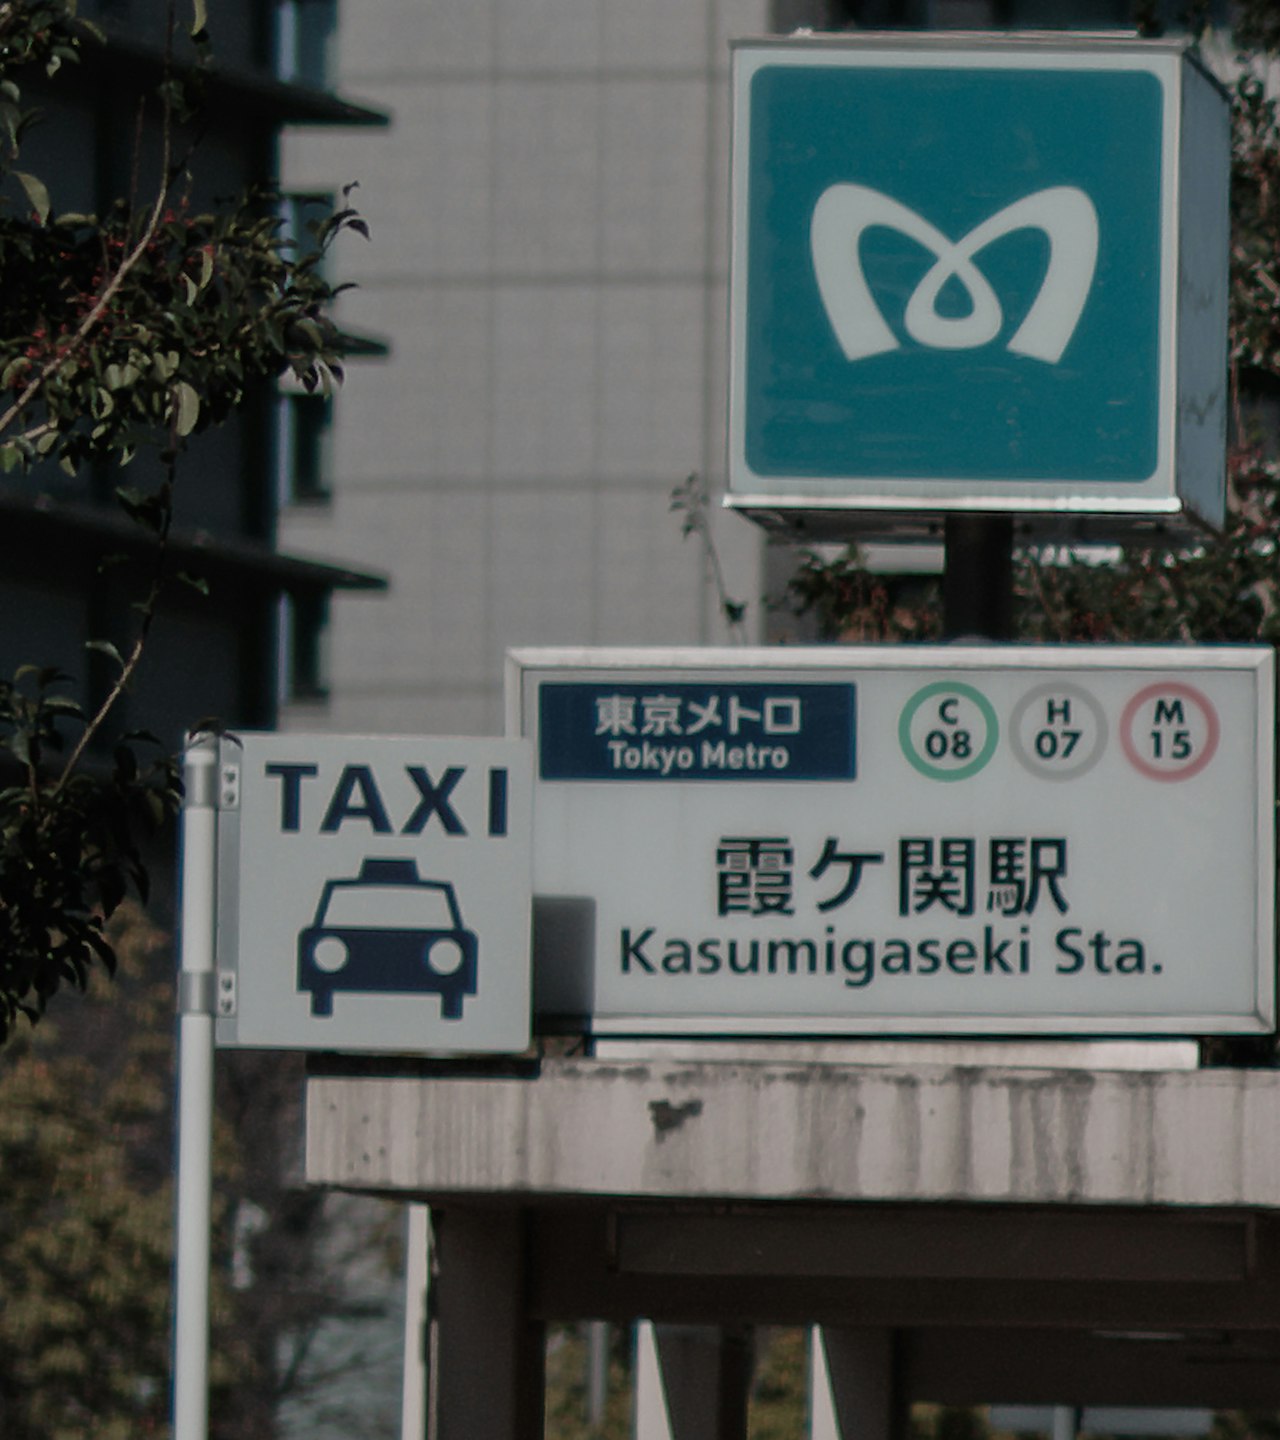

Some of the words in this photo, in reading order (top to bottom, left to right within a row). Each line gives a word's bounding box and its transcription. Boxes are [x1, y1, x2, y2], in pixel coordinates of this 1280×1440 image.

[595, 694, 801, 736] 東京メトロ
[938, 698, 960, 726] C
[1047, 699, 1072, 725] H
[1154, 699, 1185, 724] M
[608, 740, 694, 775] Tokyo
[702, 741, 789, 769] Metro
[925, 730, 973, 760] 08
[1034, 730, 1082, 760] 07
[1150, 730, 1193, 760] 15
[265, 763, 508, 837] TAXI
[715, 836, 1069, 917] 霞ケ関駅
[619, 924, 1030, 988] Kasumigaseki
[1055, 927, 1163, 975] Sta.
